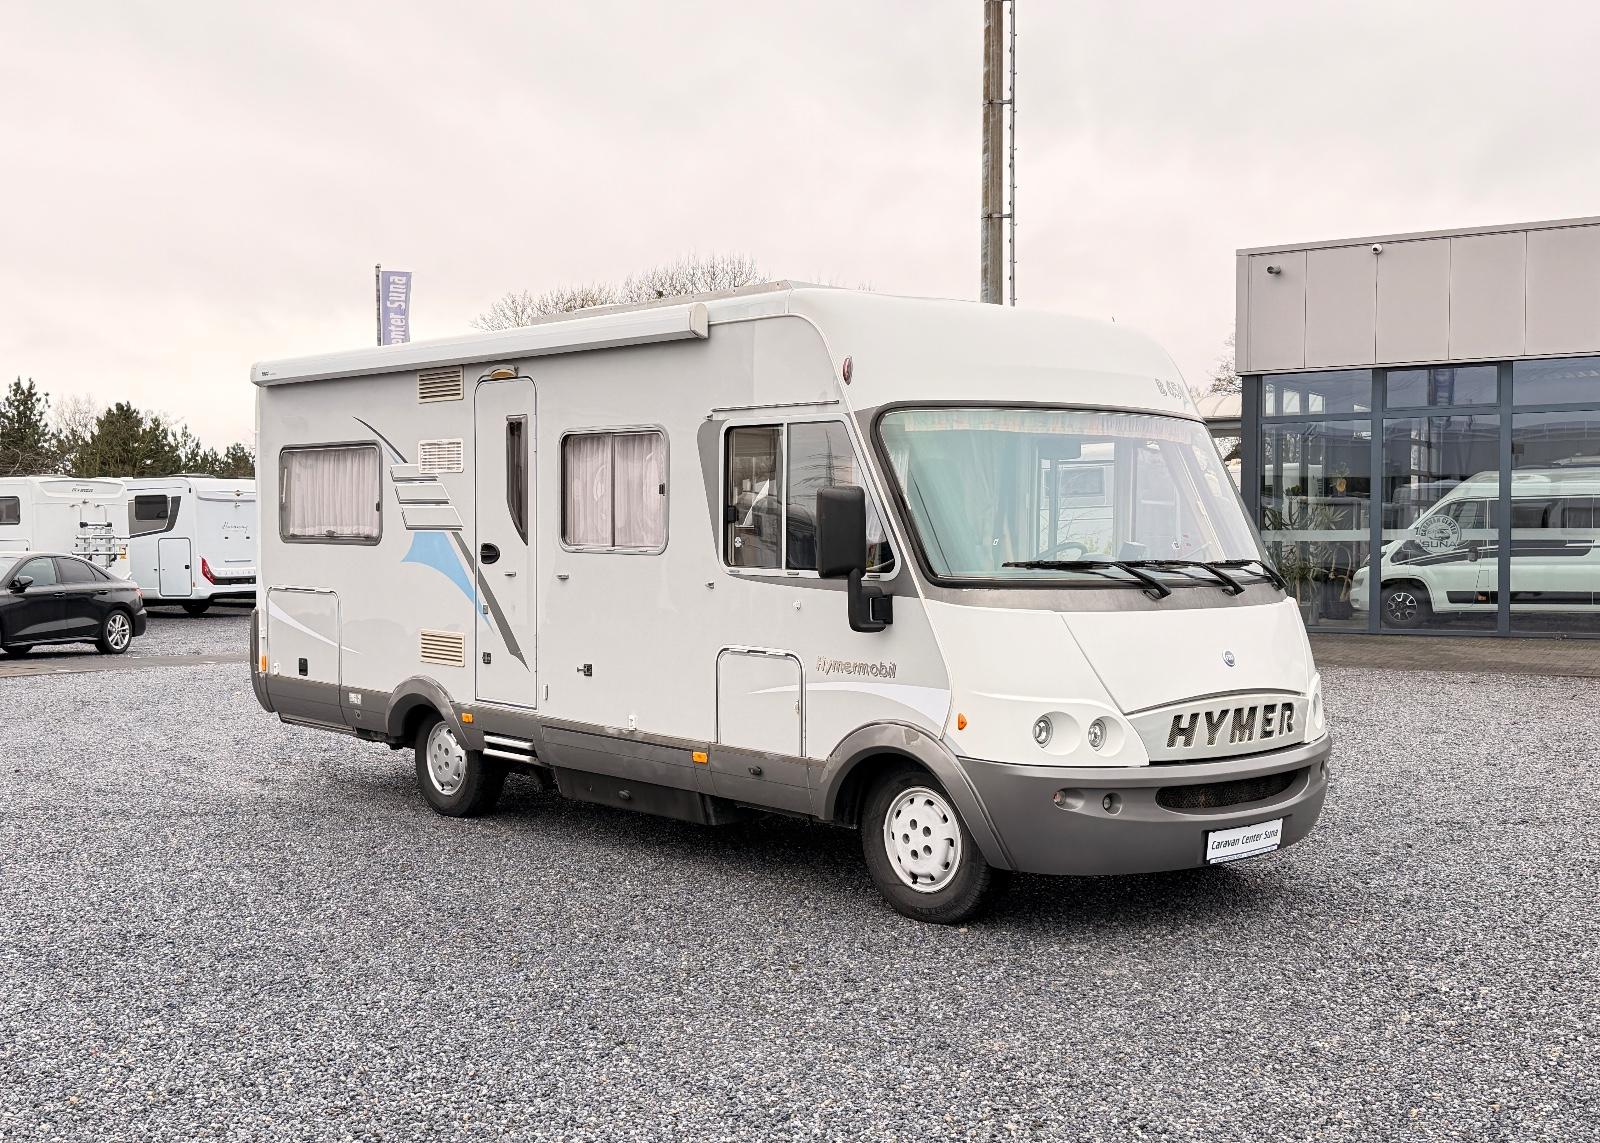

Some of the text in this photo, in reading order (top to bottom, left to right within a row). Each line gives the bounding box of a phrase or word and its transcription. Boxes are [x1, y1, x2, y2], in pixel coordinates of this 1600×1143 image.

[386, 275, 407, 344] enter Suna
[1421, 540, 1457, 549] SUNA
[816, 656, 897, 679] Hymermobil
[1166, 702, 1295, 748] HYMER
[1211, 828, 1279, 850] Caravan Center Suna
